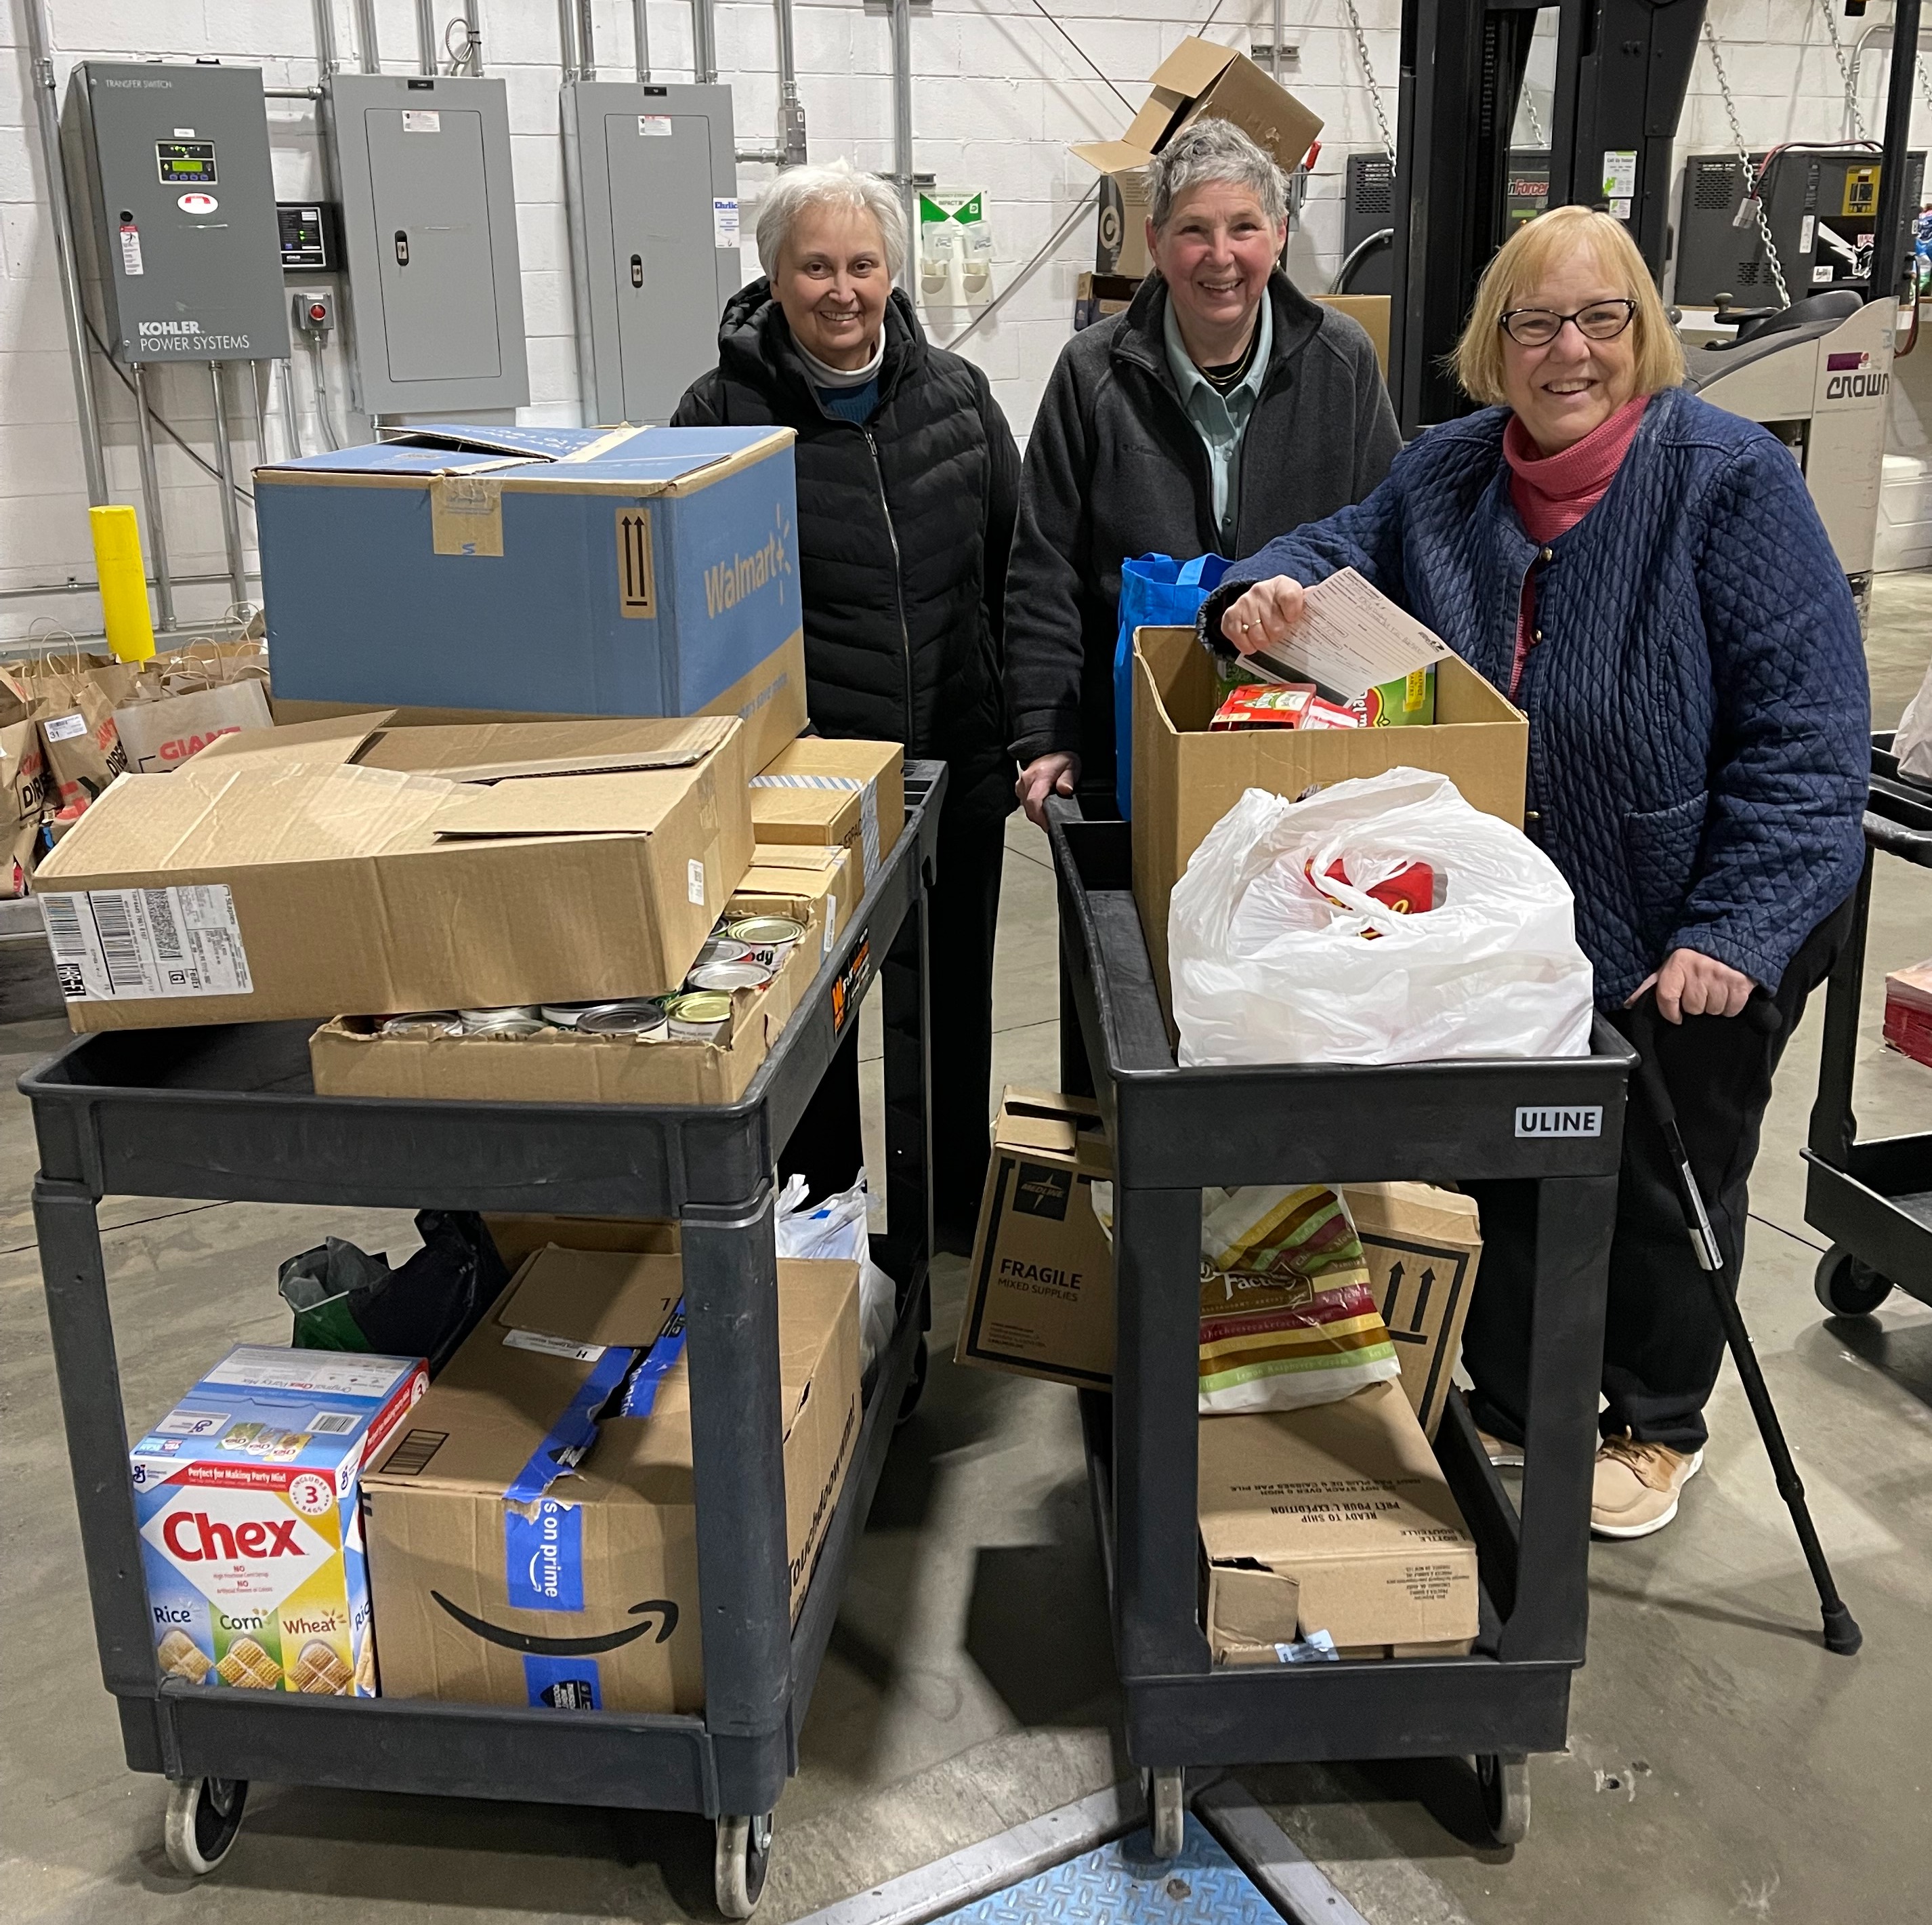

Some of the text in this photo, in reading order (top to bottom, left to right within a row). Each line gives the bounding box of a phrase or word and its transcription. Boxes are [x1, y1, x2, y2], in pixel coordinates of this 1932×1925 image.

[106, 79, 171, 88] TRANSFER SWITCH
[1508, 178, 1549, 195] nForcer
[140, 335, 250, 352] POWER SYSTEMS
[704, 531, 777, 620] Walmart
[49, 731, 60, 739] 31
[190, 968, 201, 989] FedEx
[1521, 1112, 1595, 1132] ULINE
[1021, 1182, 1064, 1199] MEDLINE
[1001, 1258, 1083, 1290] FRAGILE
[998, 1278, 1079, 1302] MIXED SUPPLIES
[289, 1381, 314, 1390] Chex
[188, 1468, 213, 1481] Perfect
[214, 1468, 224, 1481] for
[225, 1470, 251, 1482] Making
[252, 1471, 270, 1483] Party
[293, 1476, 328, 1491] INCLUDES
[305, 1486, 318, 1504] 3
[302, 1505, 323, 1514] BAGS
[1344, 1502, 1370, 1511] POUR
[1301, 1511, 1377, 1523] READY TO SHIP
[163, 1512, 306, 1562] Chex
[544, 1517, 558, 1540] on
[540, 1544, 562, 1598] prime
[153, 1607, 192, 1624] Rice
[219, 1615, 264, 1630] Corn
[283, 1617, 337, 1634] Wheat
